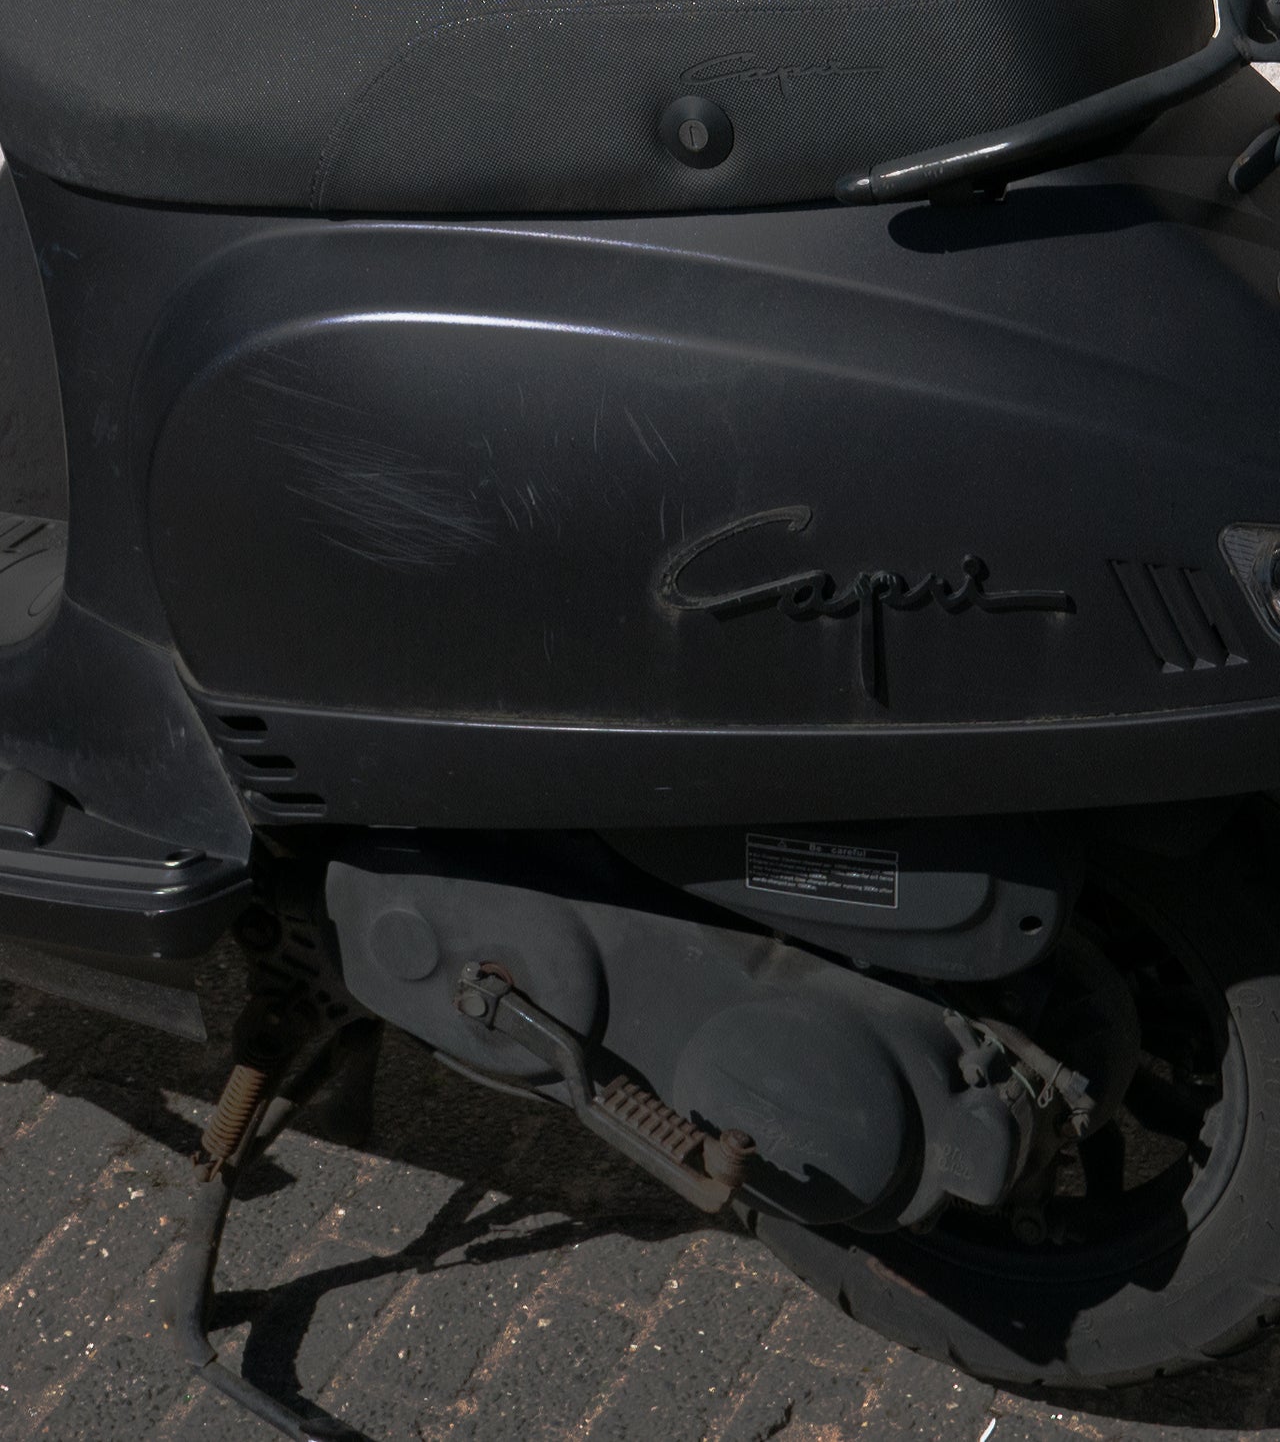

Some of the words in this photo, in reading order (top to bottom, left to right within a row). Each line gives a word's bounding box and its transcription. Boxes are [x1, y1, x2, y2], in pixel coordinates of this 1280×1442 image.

[679, 50, 884, 99] Capri
[656, 505, 1076, 708] Capri
[831, 847, 867, 858] careful
